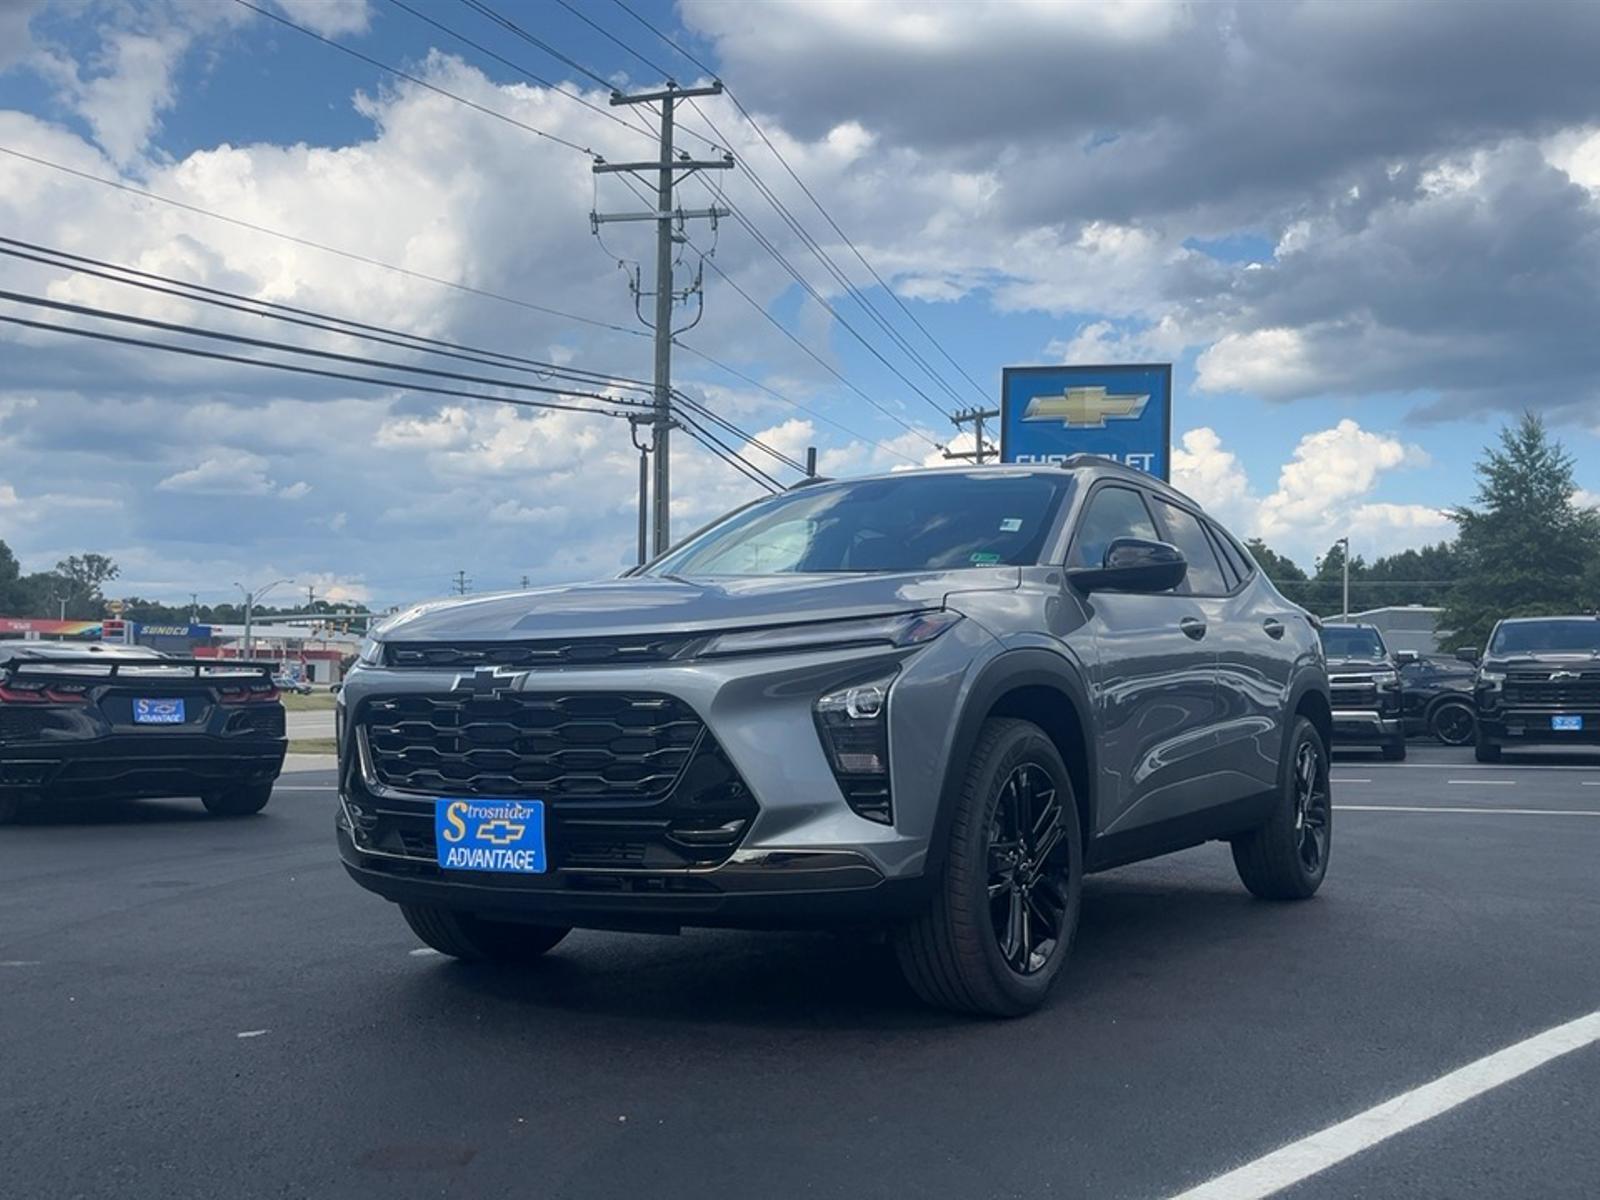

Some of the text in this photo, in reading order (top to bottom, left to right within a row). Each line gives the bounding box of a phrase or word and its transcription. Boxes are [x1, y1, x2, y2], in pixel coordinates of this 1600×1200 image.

[140, 626, 189, 635] SUNOCO
[443, 801, 534, 842] Strosnider
[446, 847, 535, 870] ADVANTAGE
